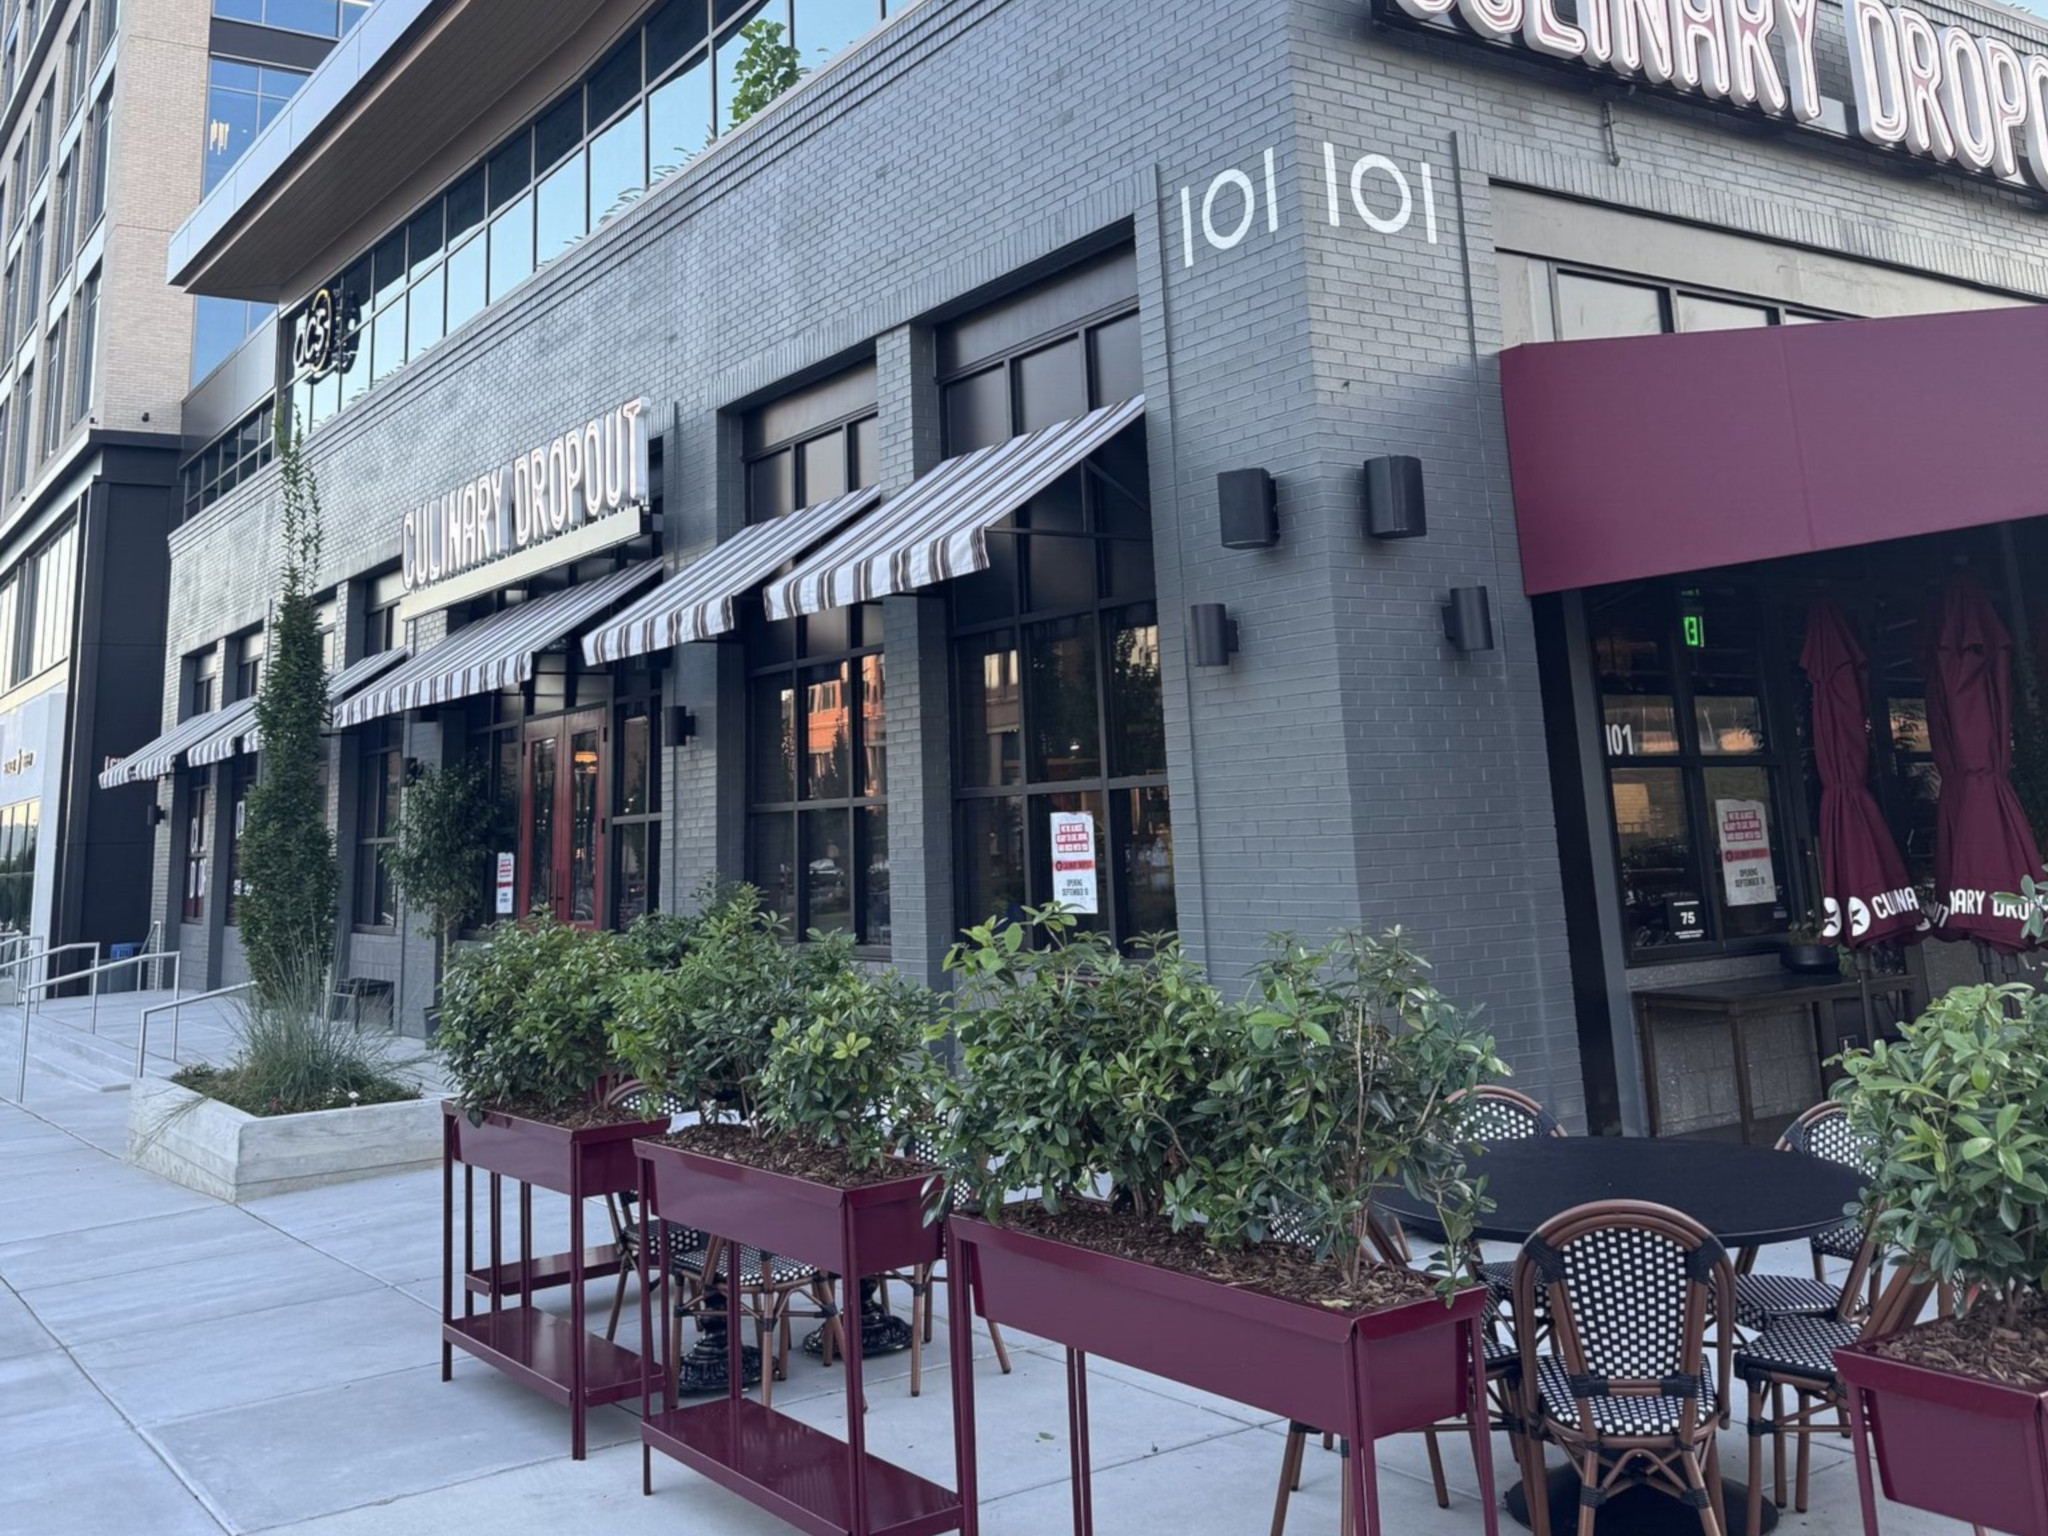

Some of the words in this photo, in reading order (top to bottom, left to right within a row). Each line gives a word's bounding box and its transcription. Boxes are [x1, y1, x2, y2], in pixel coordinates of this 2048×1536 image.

[1181, 147, 1279, 268] 101
[1323, 142, 1438, 245] 101
[402, 467, 511, 590] CULINARY
[514, 397, 648, 547] DROPOUT
[1604, 724, 1634, 756] 101
[1680, 911, 1696, 925] 75
